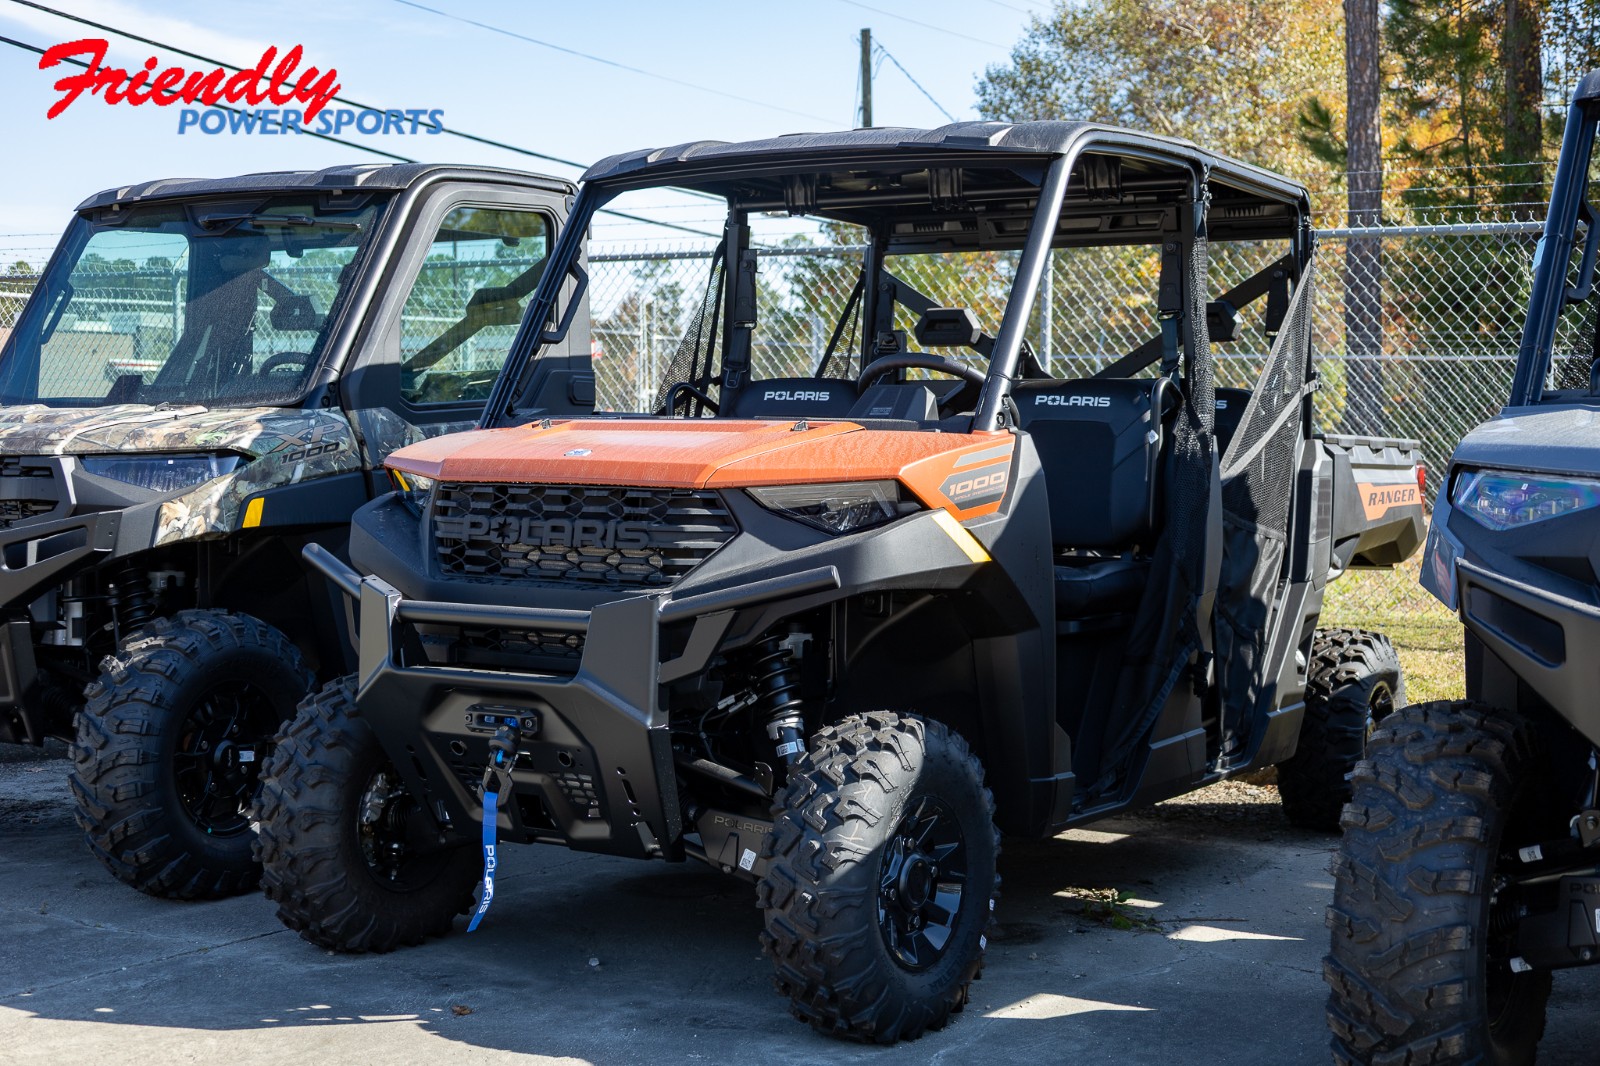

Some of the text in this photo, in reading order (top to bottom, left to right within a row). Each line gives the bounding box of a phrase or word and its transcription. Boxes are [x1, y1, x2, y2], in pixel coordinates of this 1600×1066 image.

[763, 391, 830, 401] POLARIS
[1035, 394, 1111, 407] POLARIS
[266, 421, 345, 455] XP
[281, 441, 340, 465] 1000
[948, 471, 1006, 497] 1000
[1367, 488, 1415, 506] RANGER
[462, 514, 650, 550] POLARIS
[479, 844, 497, 914] POLARIS
